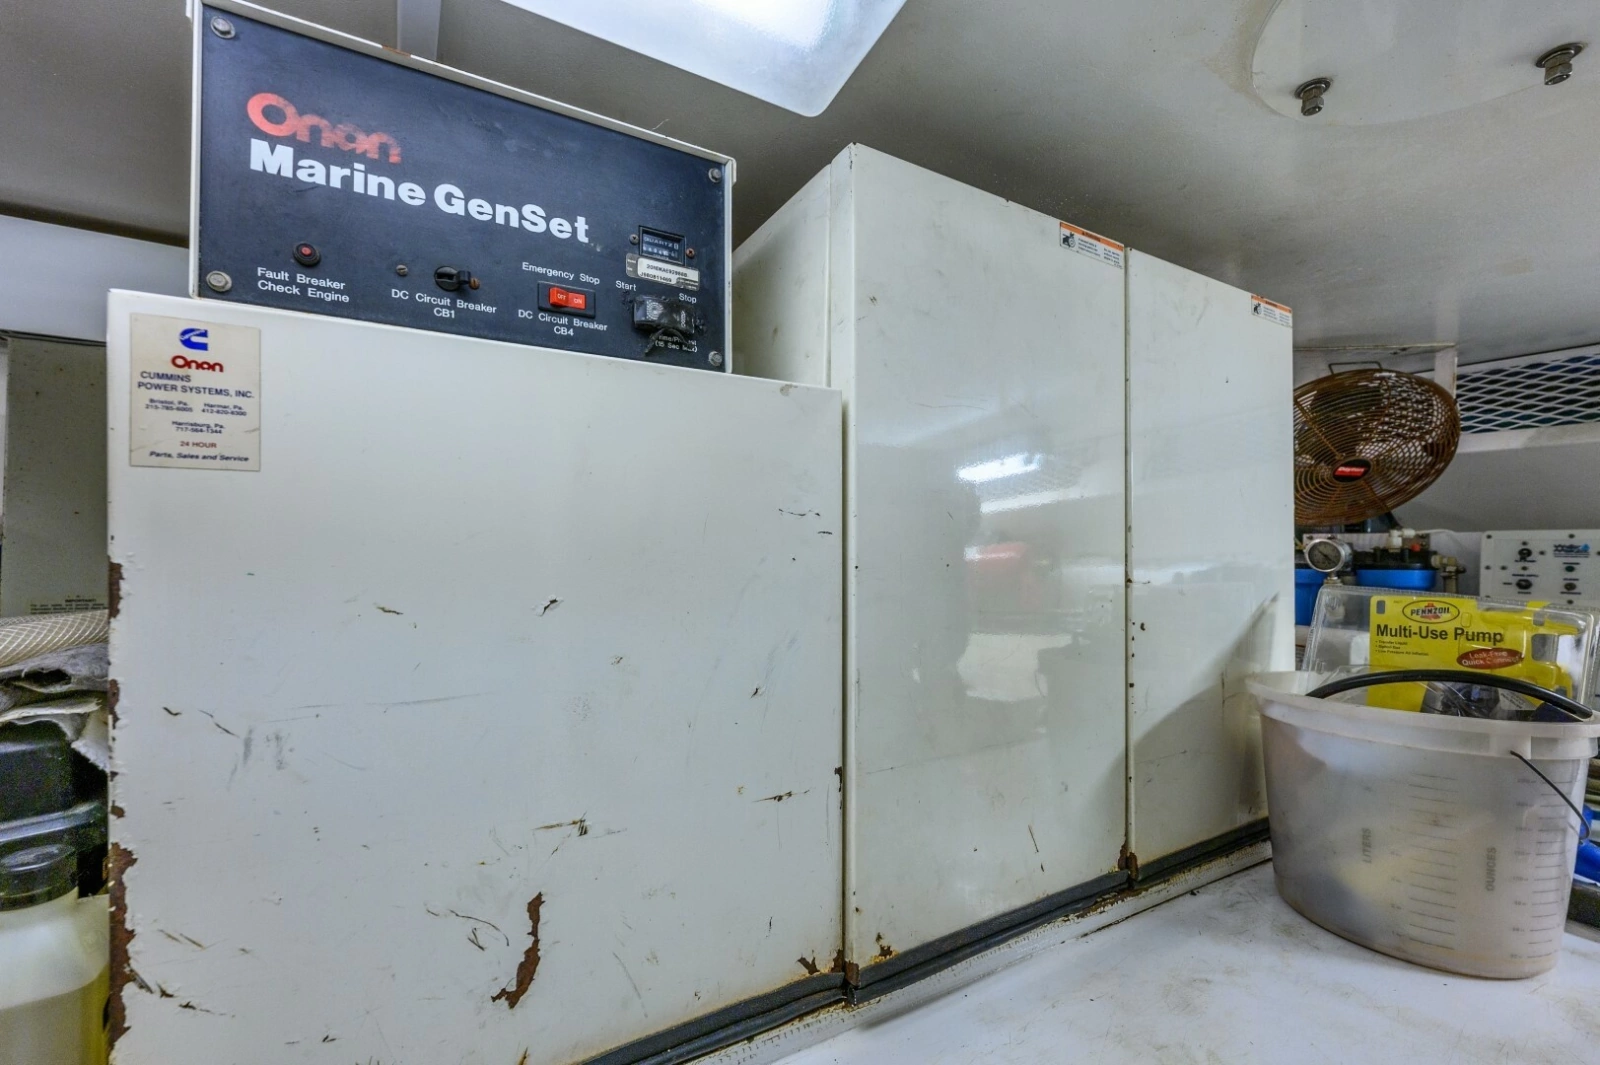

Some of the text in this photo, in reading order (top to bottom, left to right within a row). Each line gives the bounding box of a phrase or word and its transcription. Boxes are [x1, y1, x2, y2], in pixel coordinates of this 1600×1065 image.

[247, 92, 401, 164] Onan
[250, 138, 589, 243] Marine GenSet
[257, 267, 345, 290] Fault Breaker
[522, 261, 600, 285] Emergency Stop
[257, 280, 349, 303] Check Engine
[615, 280, 636, 291] Start
[391, 289, 497, 314] DC Circuit Breaker
[679, 292, 697, 304] Stop
[433, 307, 455, 318] CB1
[518, 309, 608, 331] DC Circuit Breaker
[553, 325, 574, 336] CB4
[667, 342, 680, 350] Sec
[171, 354, 224, 373] Onan
[140, 371, 192, 383] CUMMINS
[137, 381, 255, 398] POWER SYSTEMS, INC.
[176, 452, 200, 460] Sales
[219, 454, 249, 462] Service
[1410, 606, 1450, 616] PENNZOIL
[1376, 624, 1504, 646] Multi-Use Pump
[1461, 658, 1485, 666] Quick
[1361, 827, 1372, 864] LITERS
[1485, 847, 1497, 891] OUNCES
